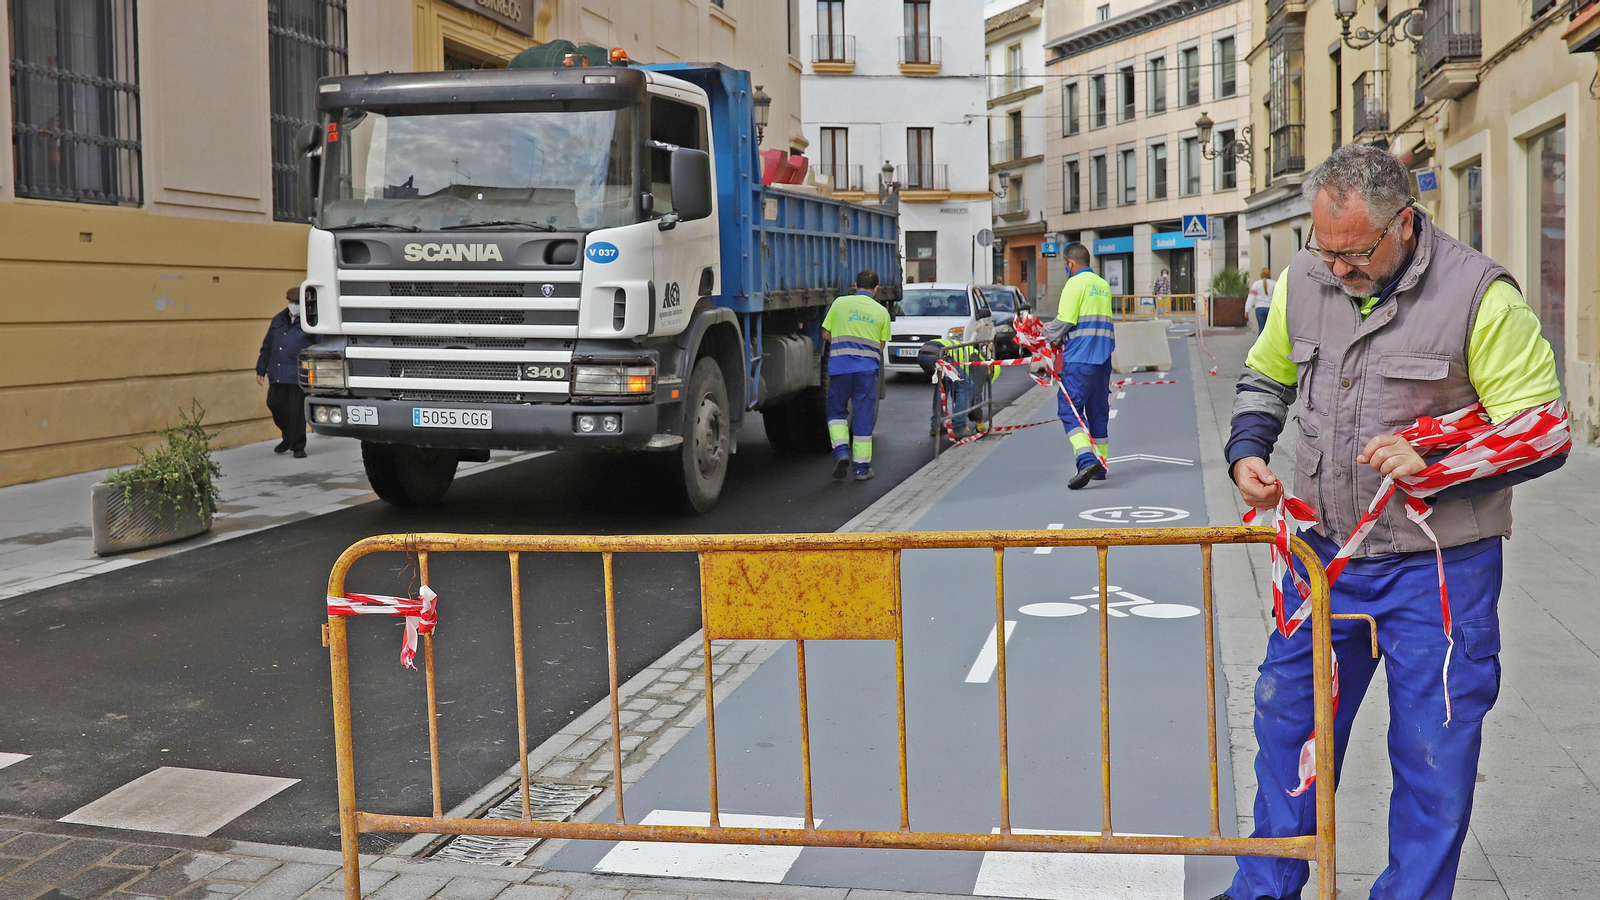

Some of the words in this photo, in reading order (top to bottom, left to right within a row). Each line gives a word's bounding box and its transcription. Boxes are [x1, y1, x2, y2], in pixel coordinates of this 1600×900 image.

[403, 243, 503, 262] SCANIA
[589, 248, 597, 257] V
[598, 248, 616, 257] 037
[526, 366, 566, 379] 340
[422, 410, 457, 425] 5055
[461, 412, 488, 426] CGG
